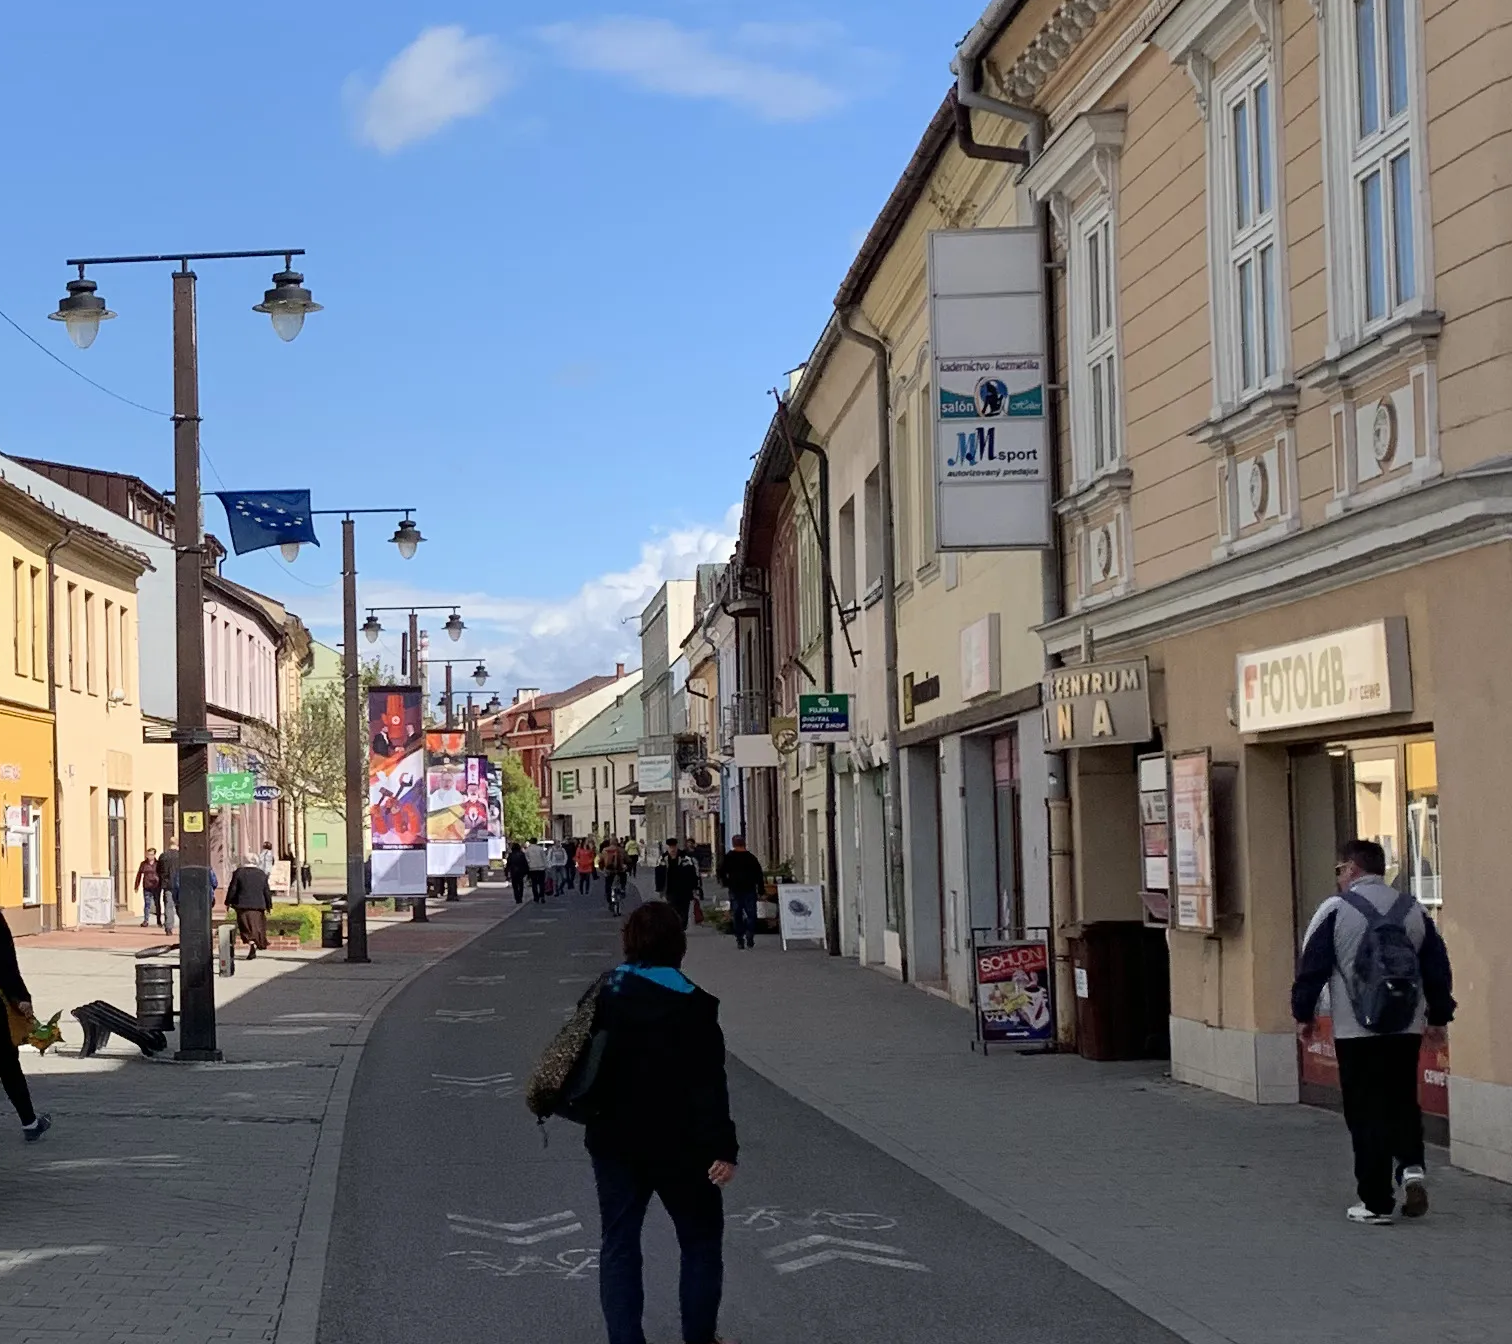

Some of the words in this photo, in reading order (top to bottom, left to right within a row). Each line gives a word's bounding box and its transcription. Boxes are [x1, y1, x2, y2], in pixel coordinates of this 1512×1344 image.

[941, 400, 974, 412] salón
[998, 449, 1038, 463] sport
[1260, 646, 1346, 717] FOTOLAB
